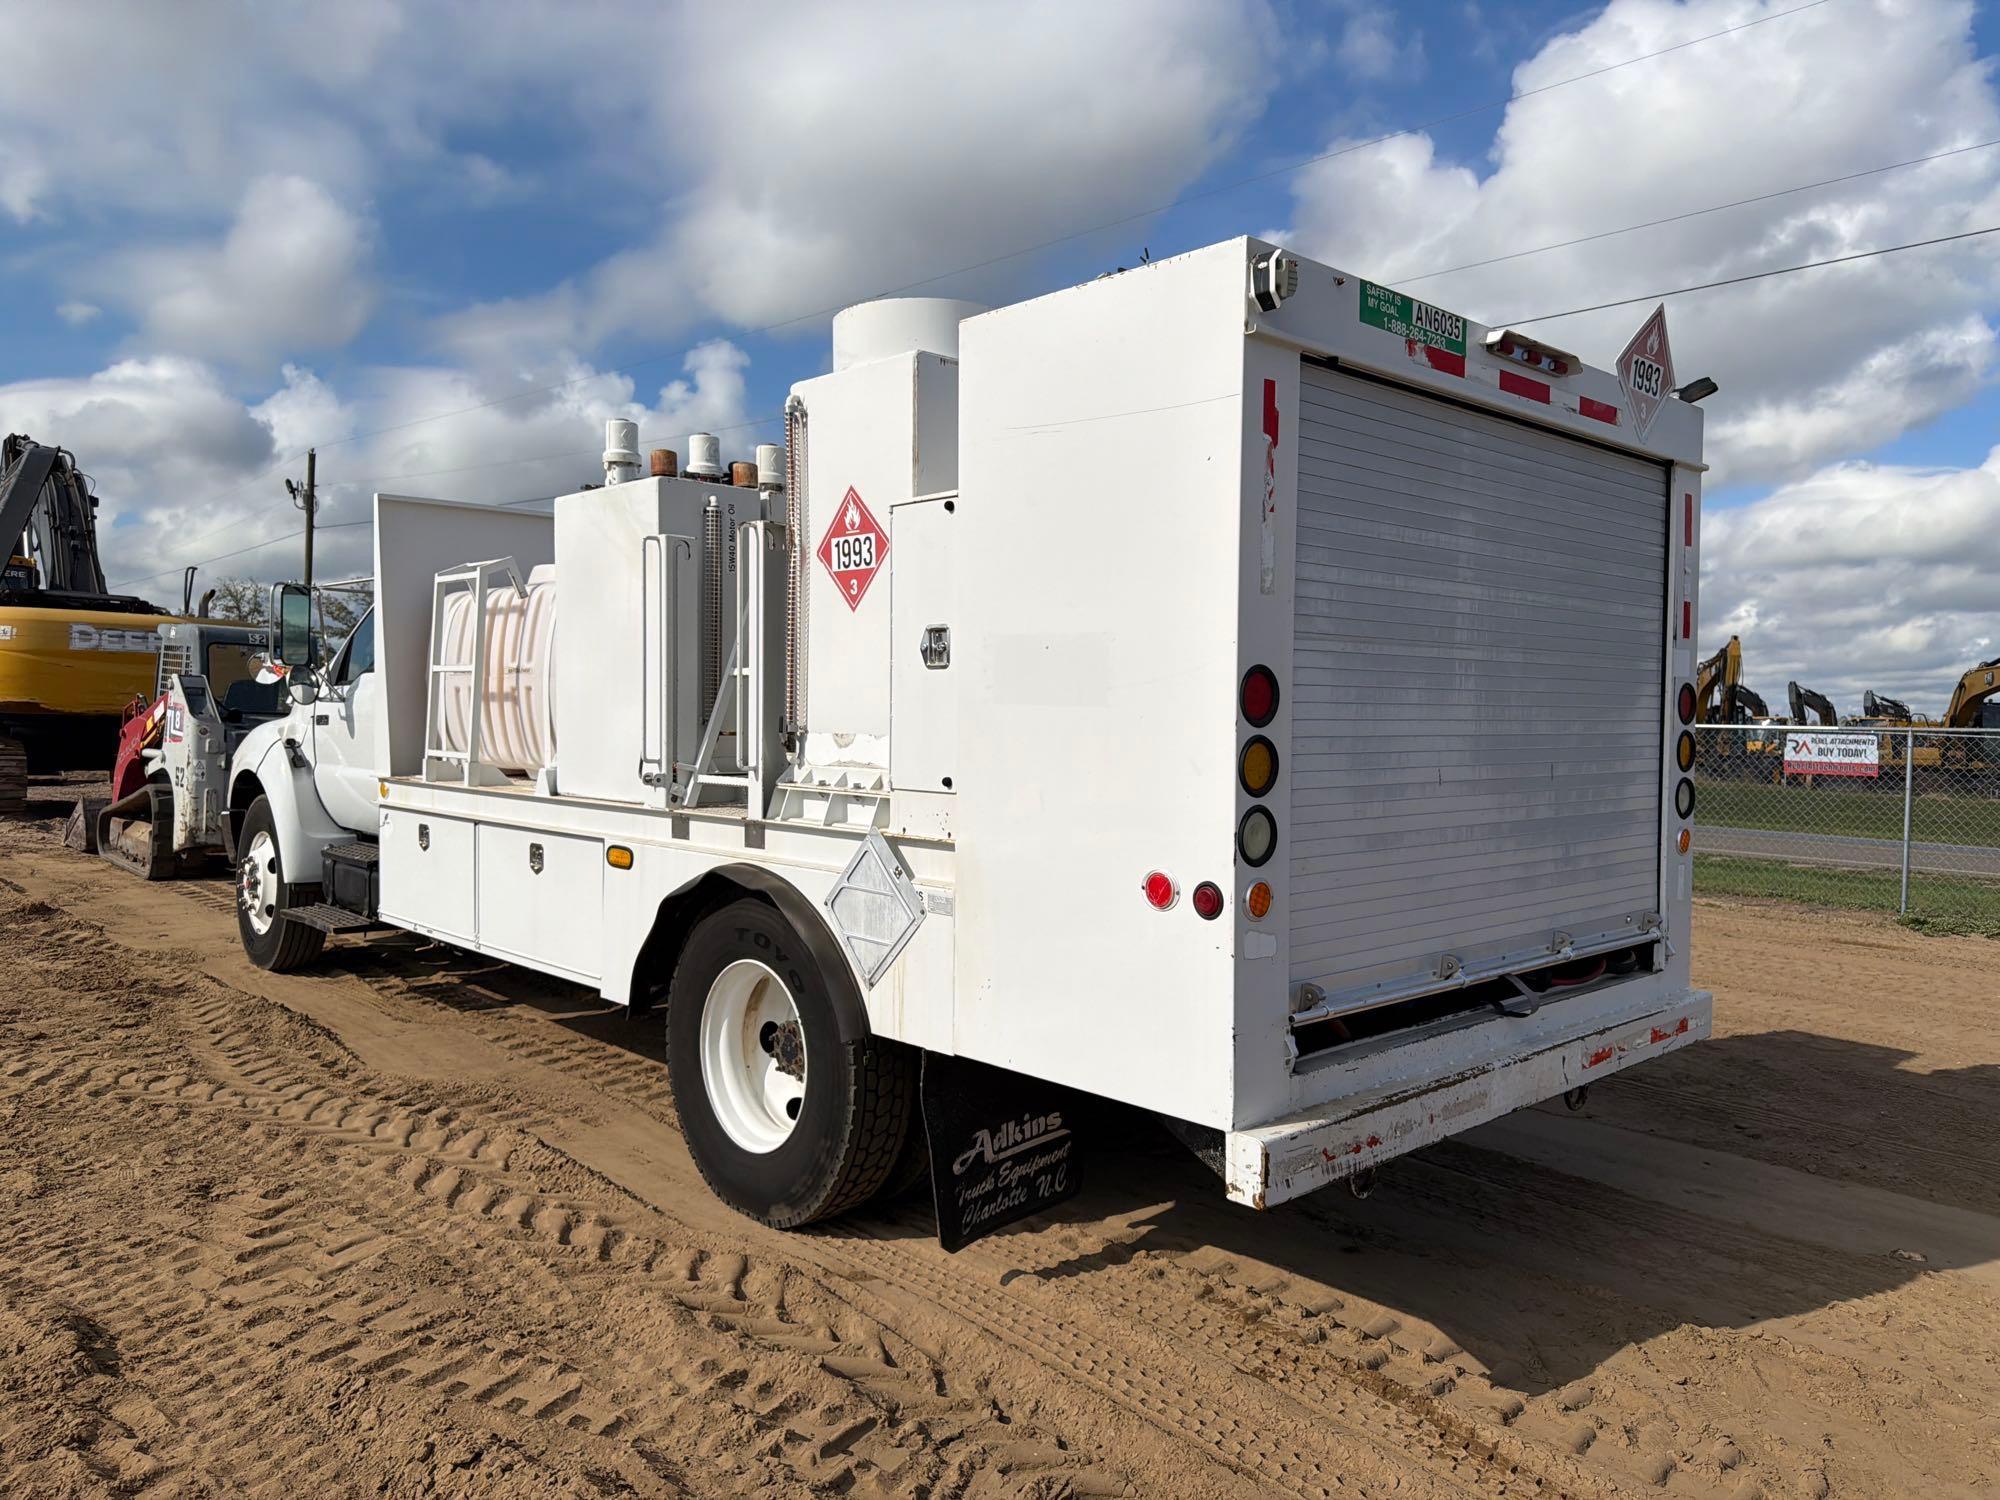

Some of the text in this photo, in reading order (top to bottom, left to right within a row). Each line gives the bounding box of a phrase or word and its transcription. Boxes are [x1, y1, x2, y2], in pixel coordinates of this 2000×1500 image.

[1366, 284, 1402, 306] SAFETY IS
[1367, 297, 1400, 318] MY GOAL
[1383, 316, 1447, 350] 1-888-264-7233
[1416, 303, 1461, 340] AN6035
[1632, 358, 1661, 397] 1993
[1640, 402, 1647, 418] 3
[727, 503, 736, 574] 15W40 Motor Oil
[834, 536, 873, 570] 1993
[849, 578, 858, 595] 3
[1817, 747, 1868, 759] BUY TODAY!
[1829, 738, 1877, 746] ATTACHMENTS
[734, 927, 806, 994] TOYO
[952, 1111, 1063, 1176] Adkins
[955, 1140, 1073, 1208] Truck Equipment
[962, 1185, 1028, 1236] Charlotte
